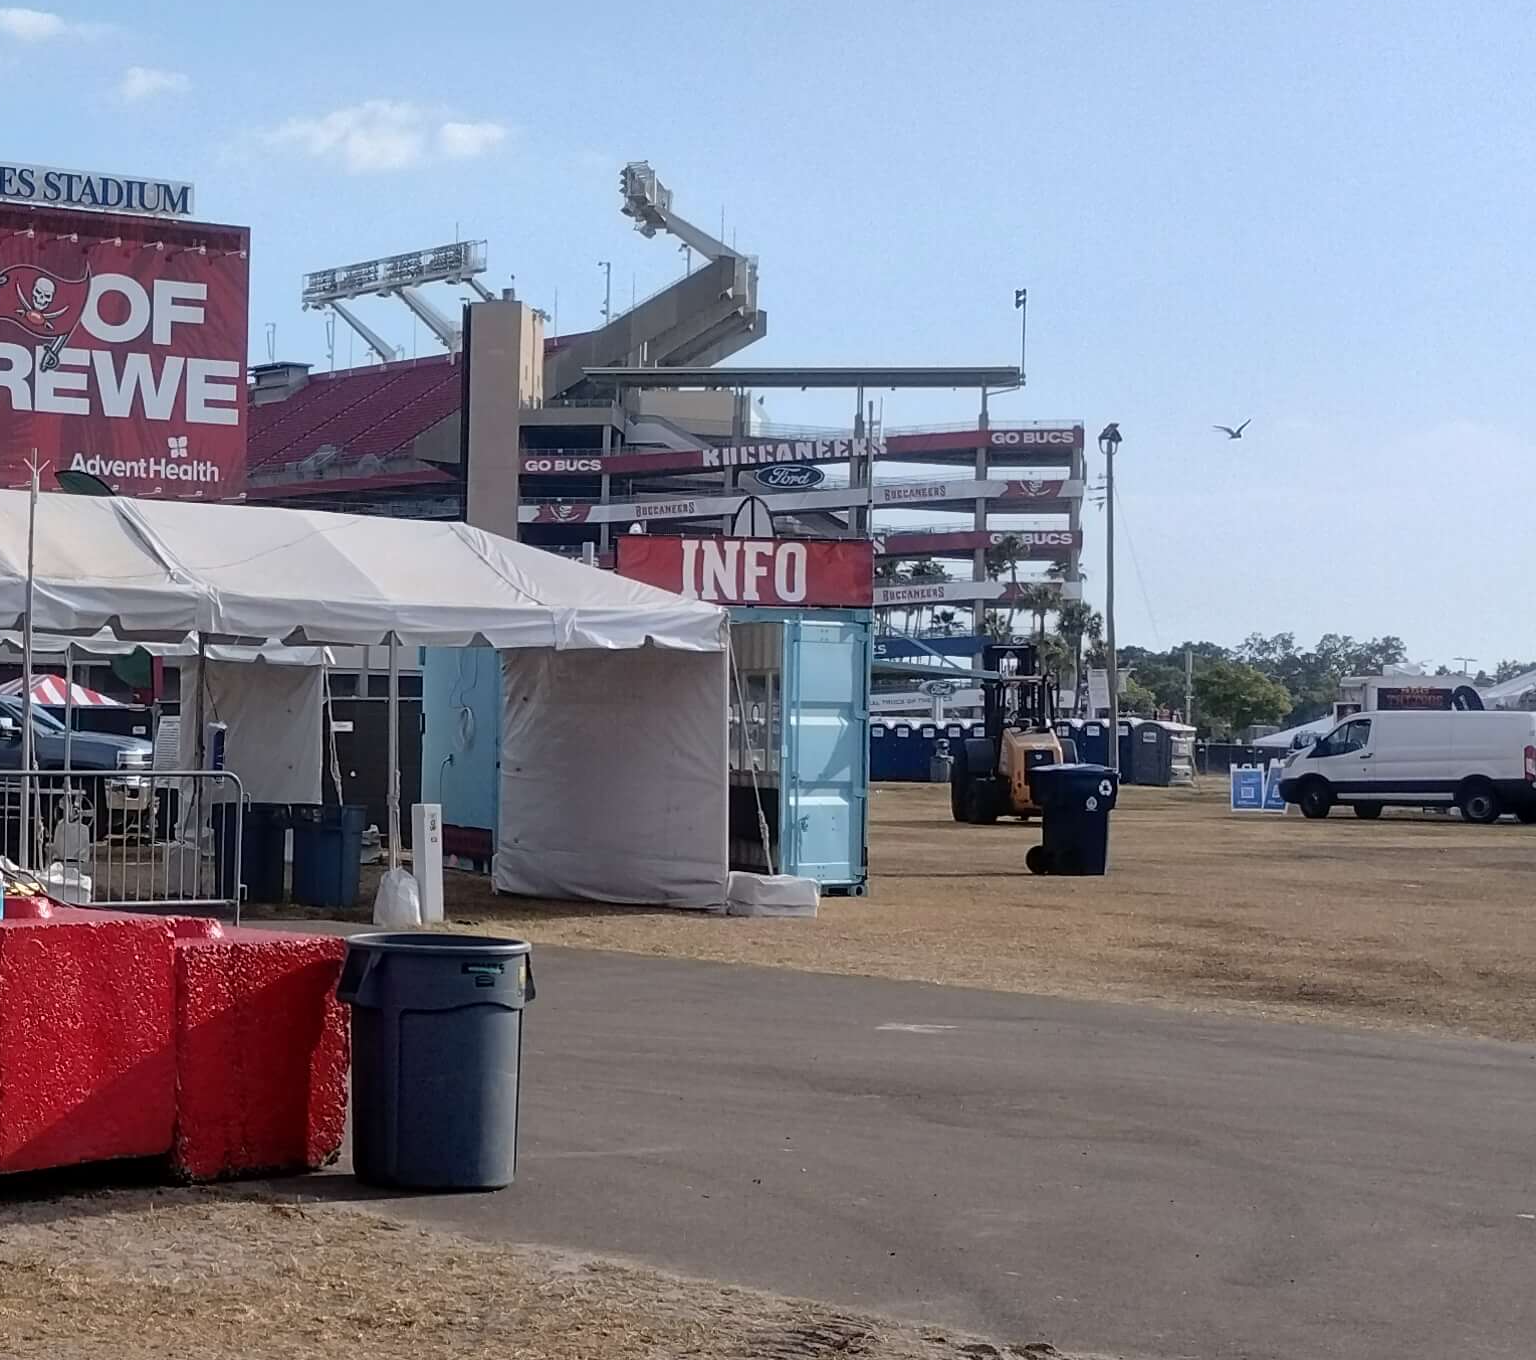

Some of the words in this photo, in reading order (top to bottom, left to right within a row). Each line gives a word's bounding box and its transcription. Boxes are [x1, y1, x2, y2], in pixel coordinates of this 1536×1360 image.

[41, 170, 191, 216] STADIUM
[80, 273, 208, 346] OF
[991, 432, 1020, 445] GO
[1023, 431, 1075, 444] BUCS
[70, 453, 219, 482] AdventHealth
[525, 459, 553, 472] GO
[554, 458, 602, 472] BUCS
[768, 468, 810, 484] Ford
[635, 501, 696, 518] BUCCANEERS
[680, 540, 807, 602] INFO
